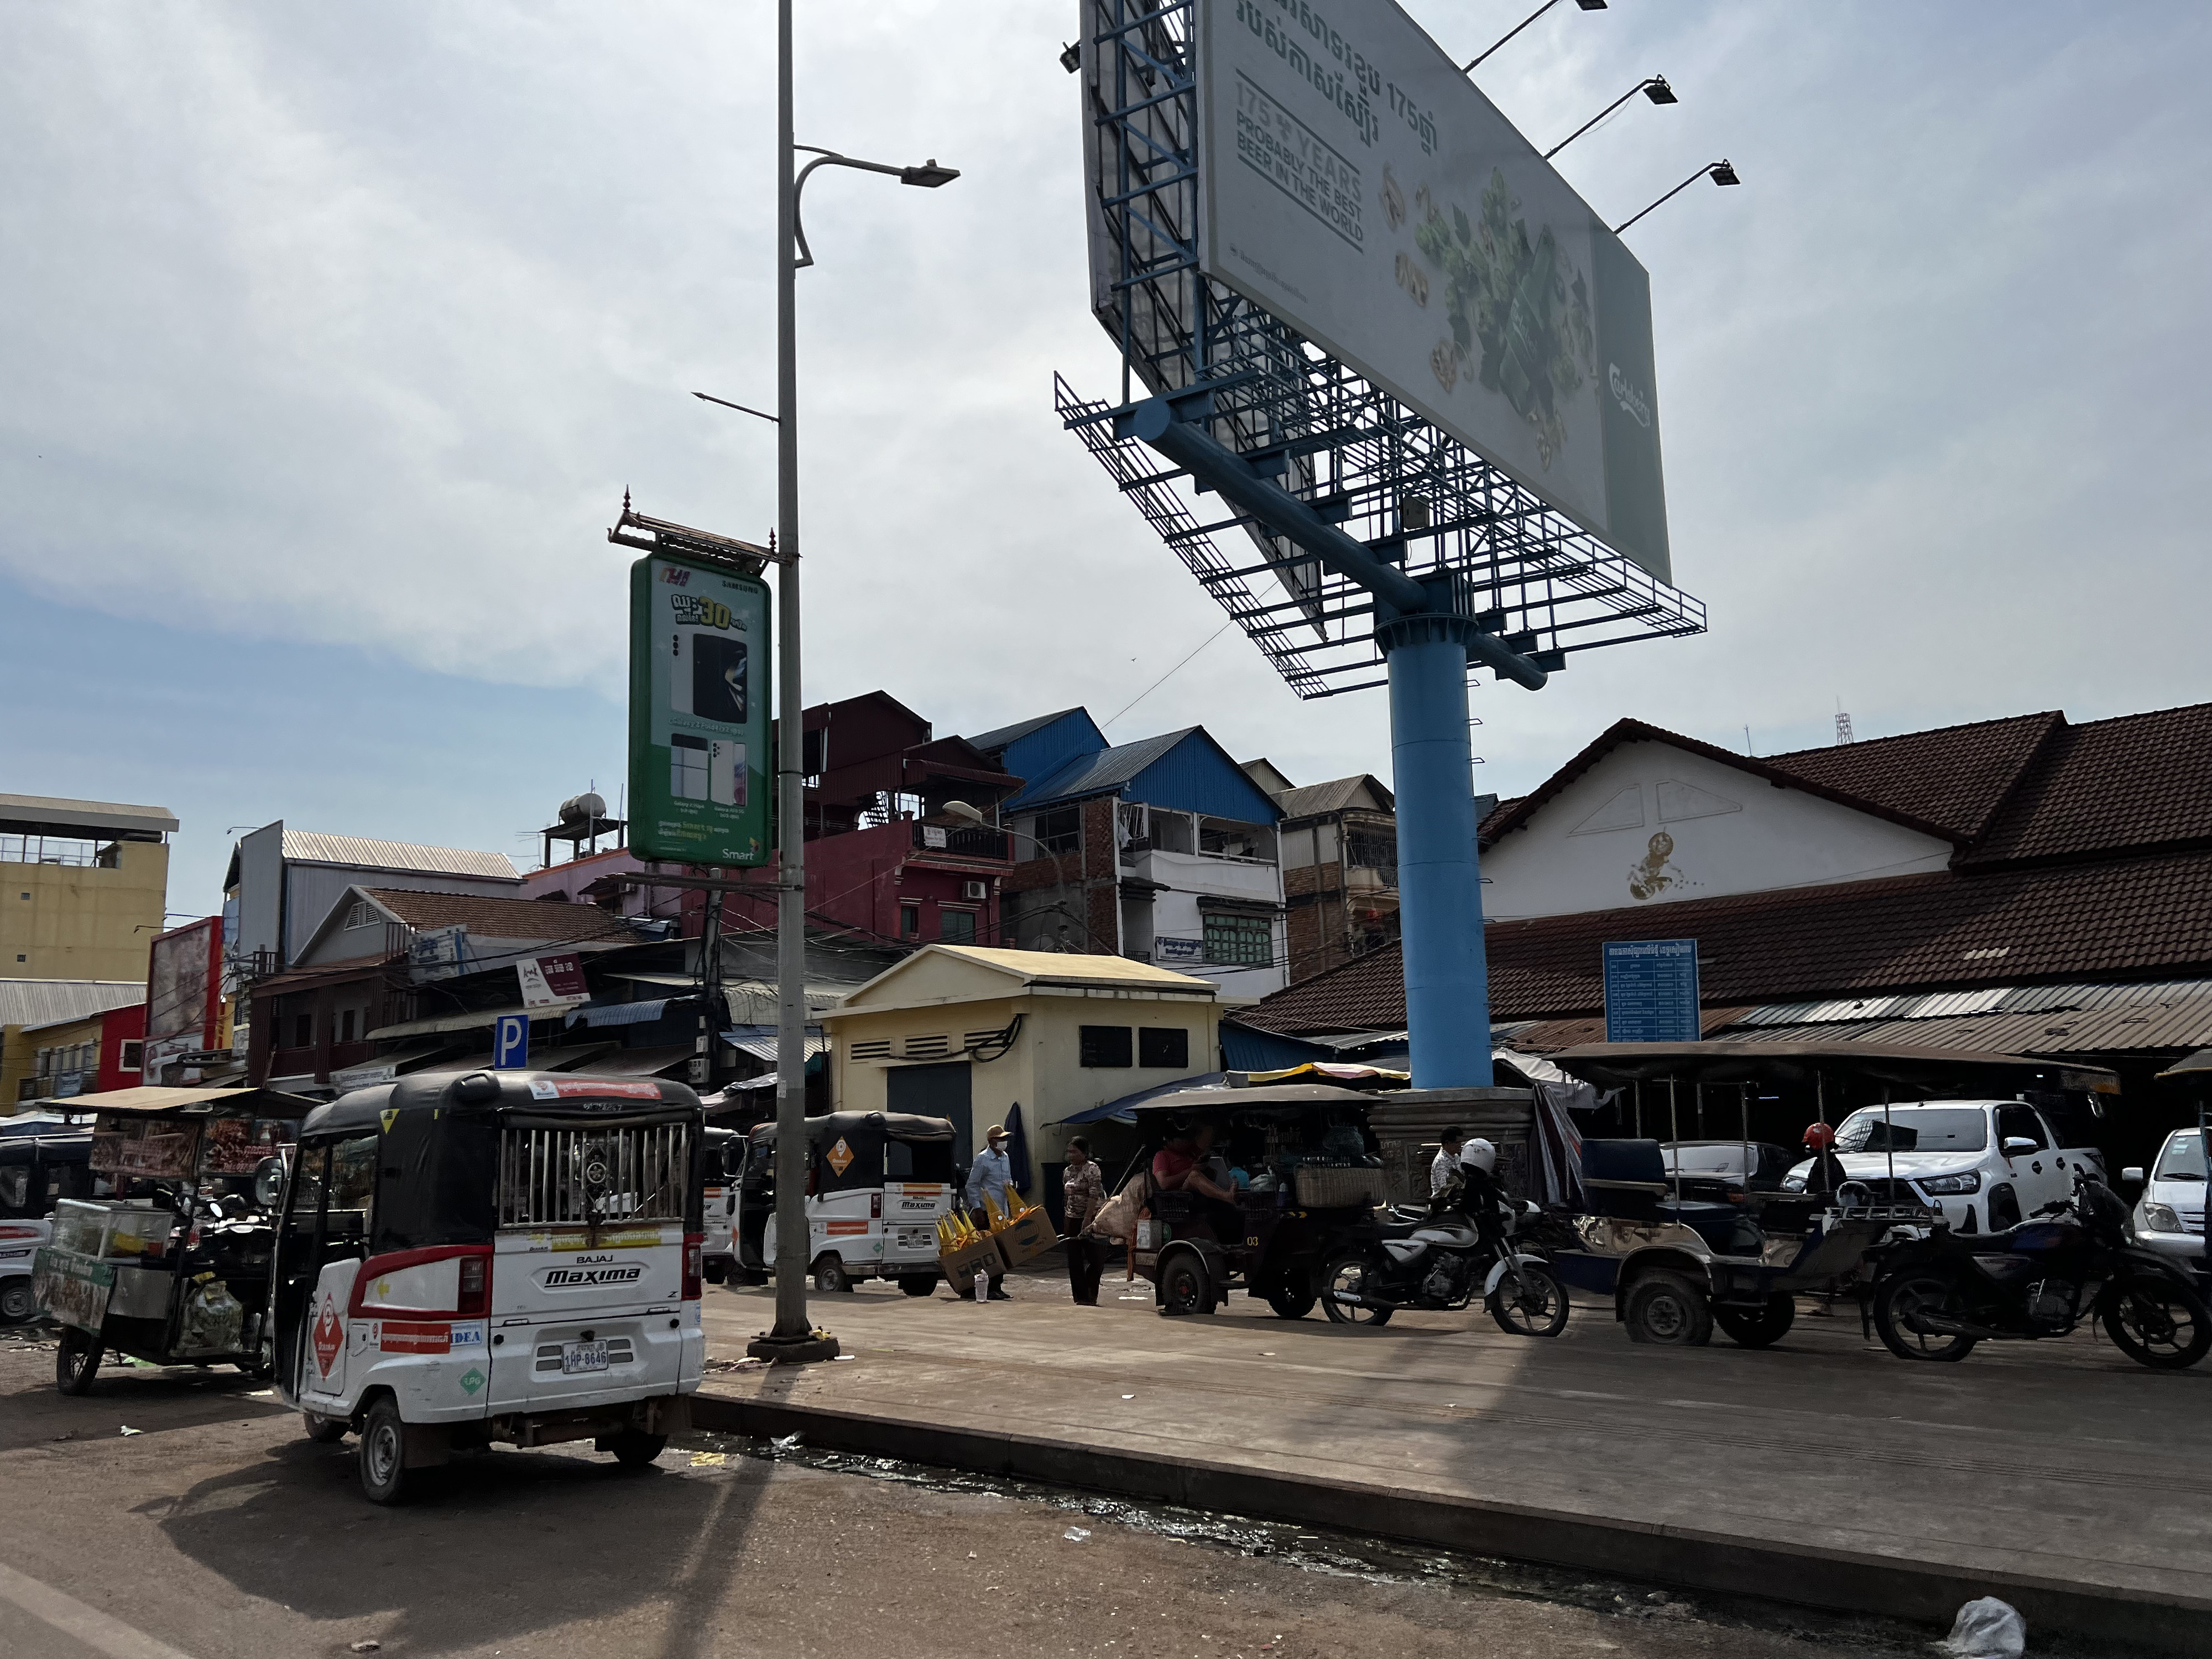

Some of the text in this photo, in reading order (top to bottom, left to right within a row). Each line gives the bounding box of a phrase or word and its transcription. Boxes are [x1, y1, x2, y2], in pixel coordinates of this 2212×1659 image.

[1235, 81, 1363, 202] 175 YEARS
[1236, 108, 1362, 222] PROBABLY THE BEST
[1237, 130, 1364, 241] BEER IN THE WORLD
[1609, 362, 1650, 427] Carlsberg
[722, 580, 759, 594] SAMSUNG
[722, 848, 754, 860] Smart
[500, 1018, 522, 1066] P
[1247, 1237, 1259, 1246] 03
[576, 1255, 613, 1264] BAJAJ
[545, 1268, 641, 1285] Maxima
